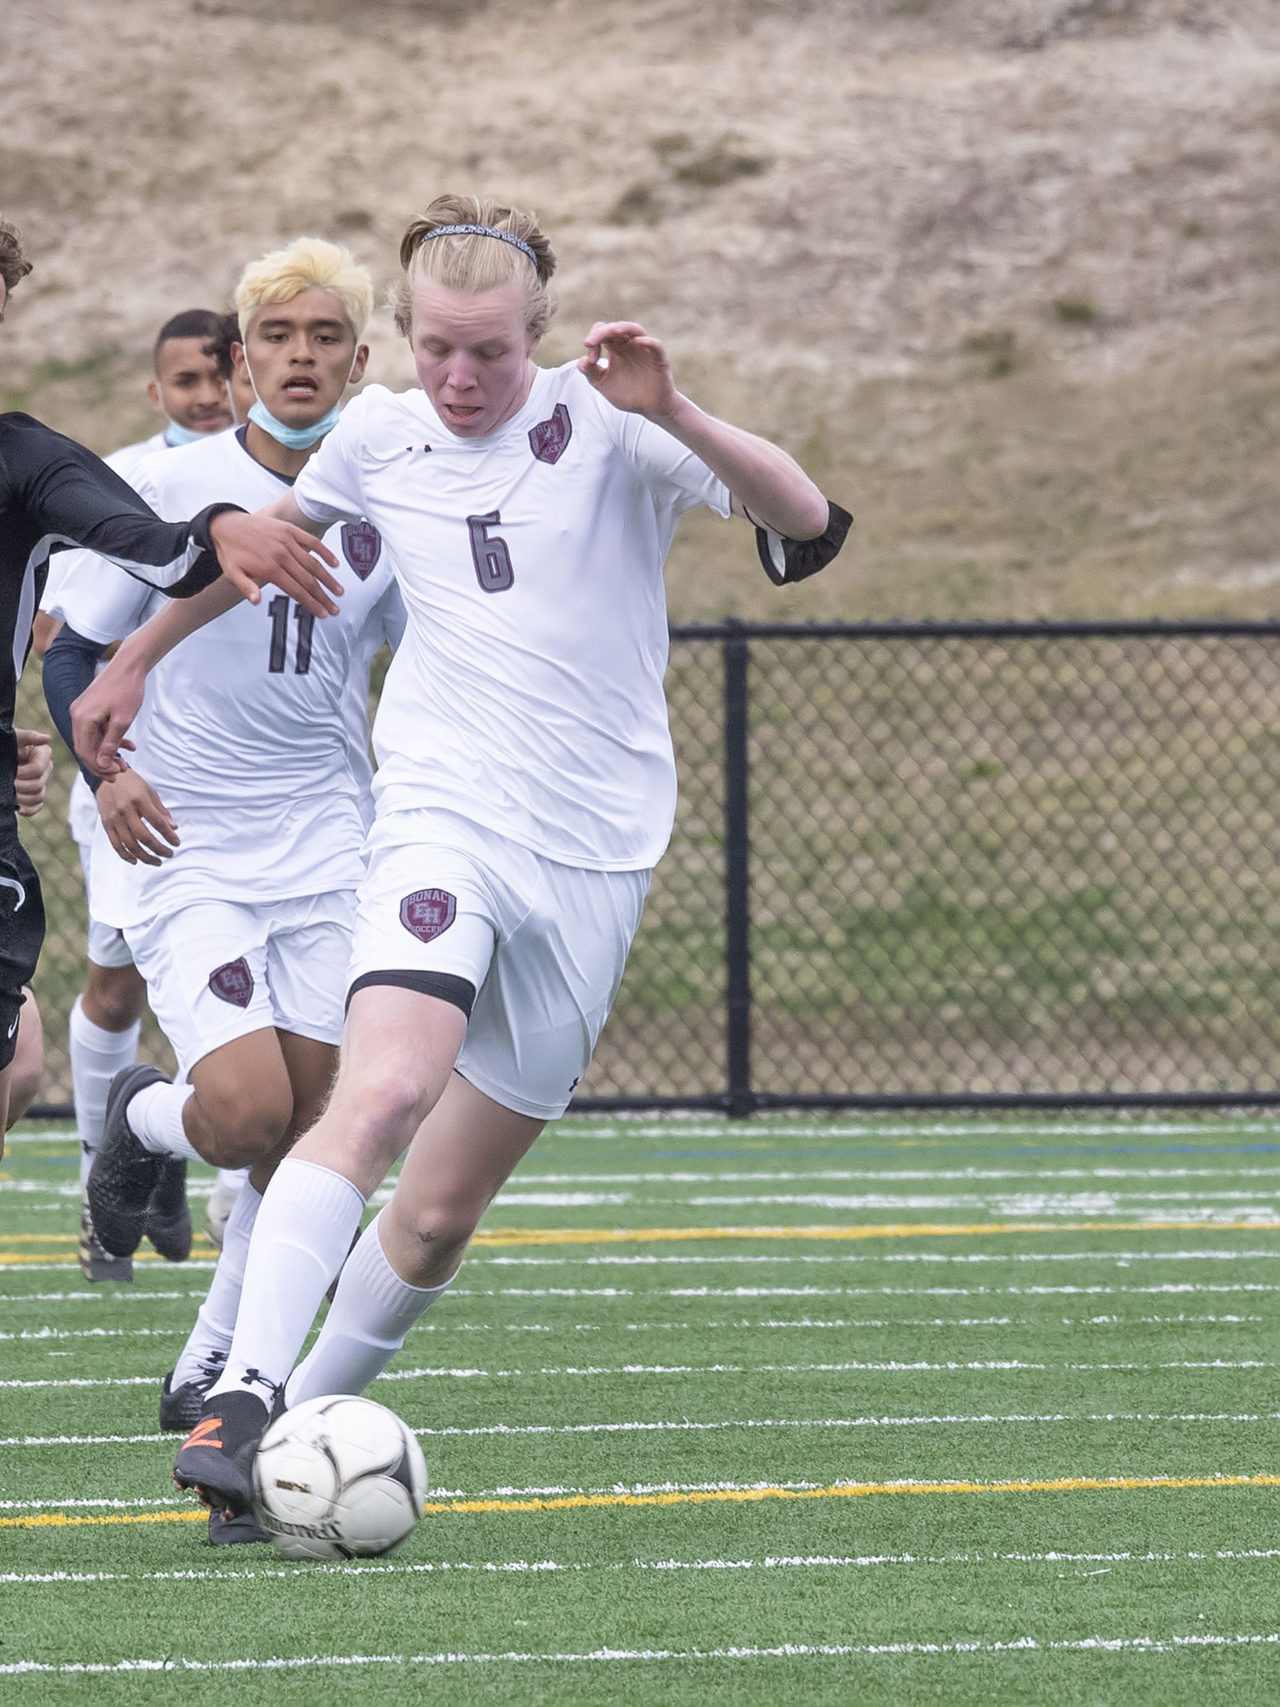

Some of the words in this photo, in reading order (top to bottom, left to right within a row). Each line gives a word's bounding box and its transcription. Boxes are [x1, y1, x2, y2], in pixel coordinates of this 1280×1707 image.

[466, 510, 515, 594] 6
[268, 595, 315, 675] 11
[409, 890, 448, 905] BONAC
